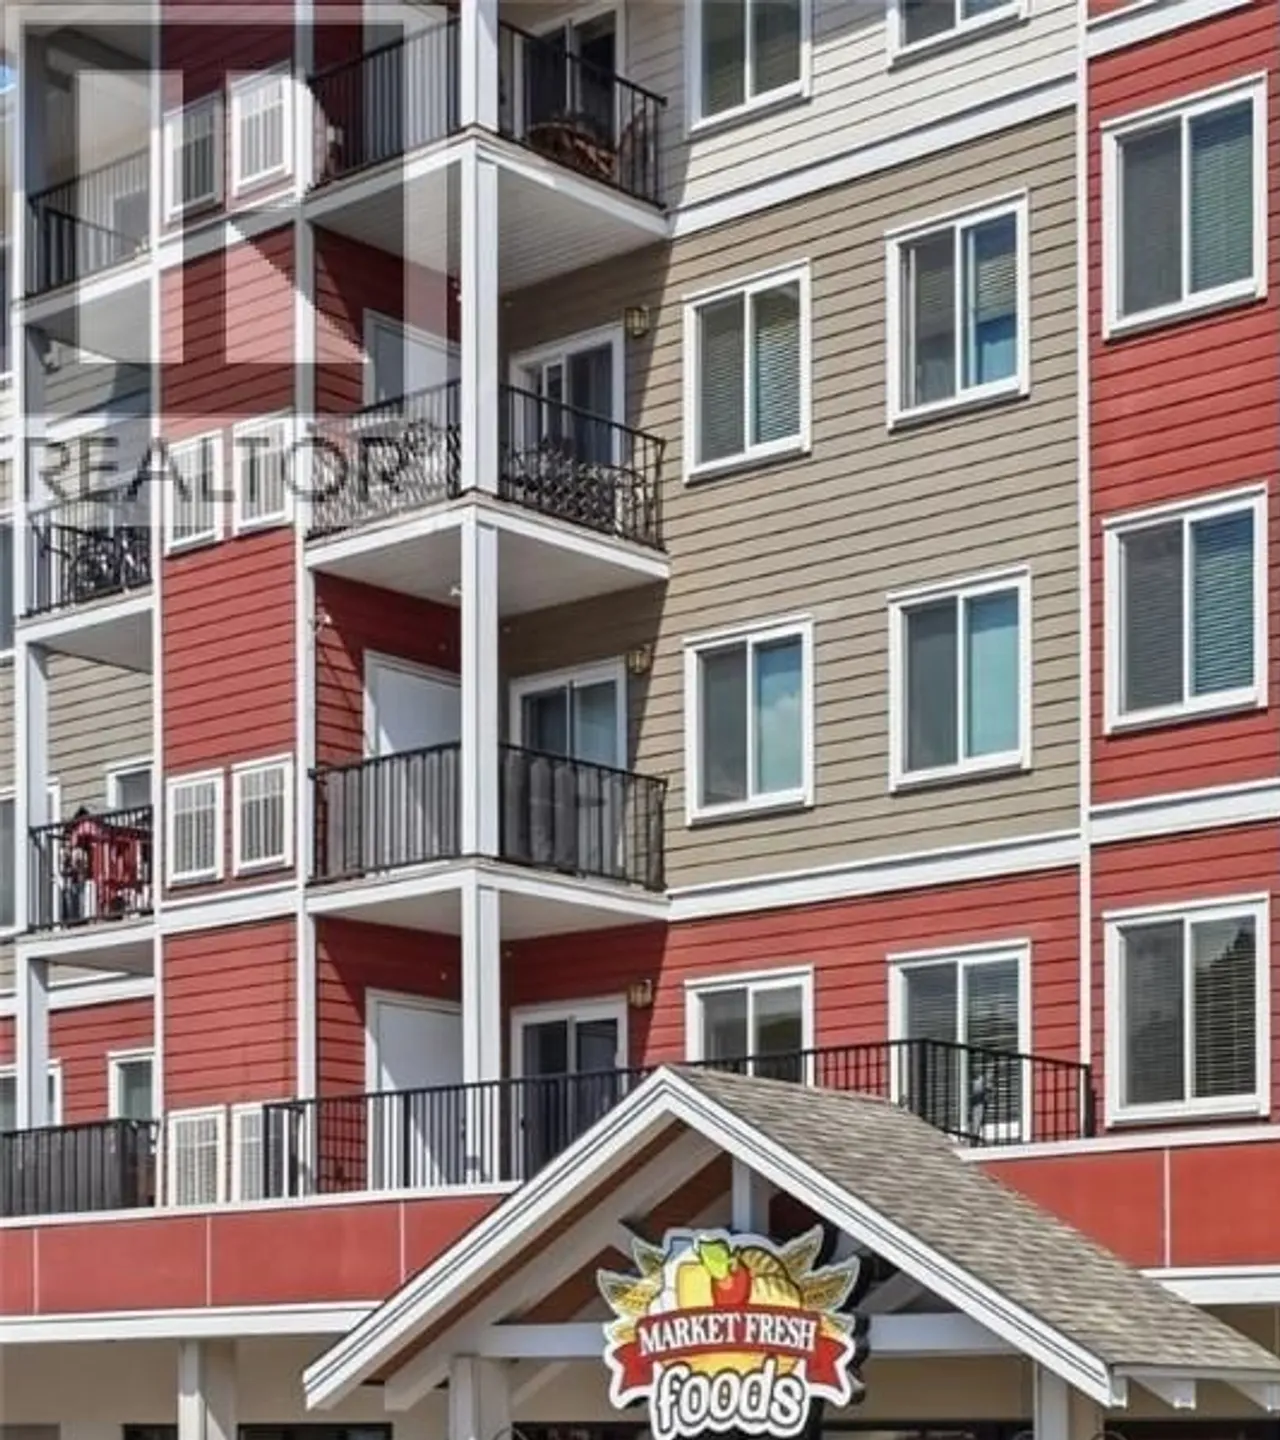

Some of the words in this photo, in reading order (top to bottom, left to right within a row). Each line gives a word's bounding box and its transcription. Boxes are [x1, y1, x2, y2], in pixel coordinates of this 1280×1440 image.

[639, 1313, 742, 1355] MARKET
[743, 1313, 817, 1351] FRESH
[655, 1357, 807, 1435] foods
